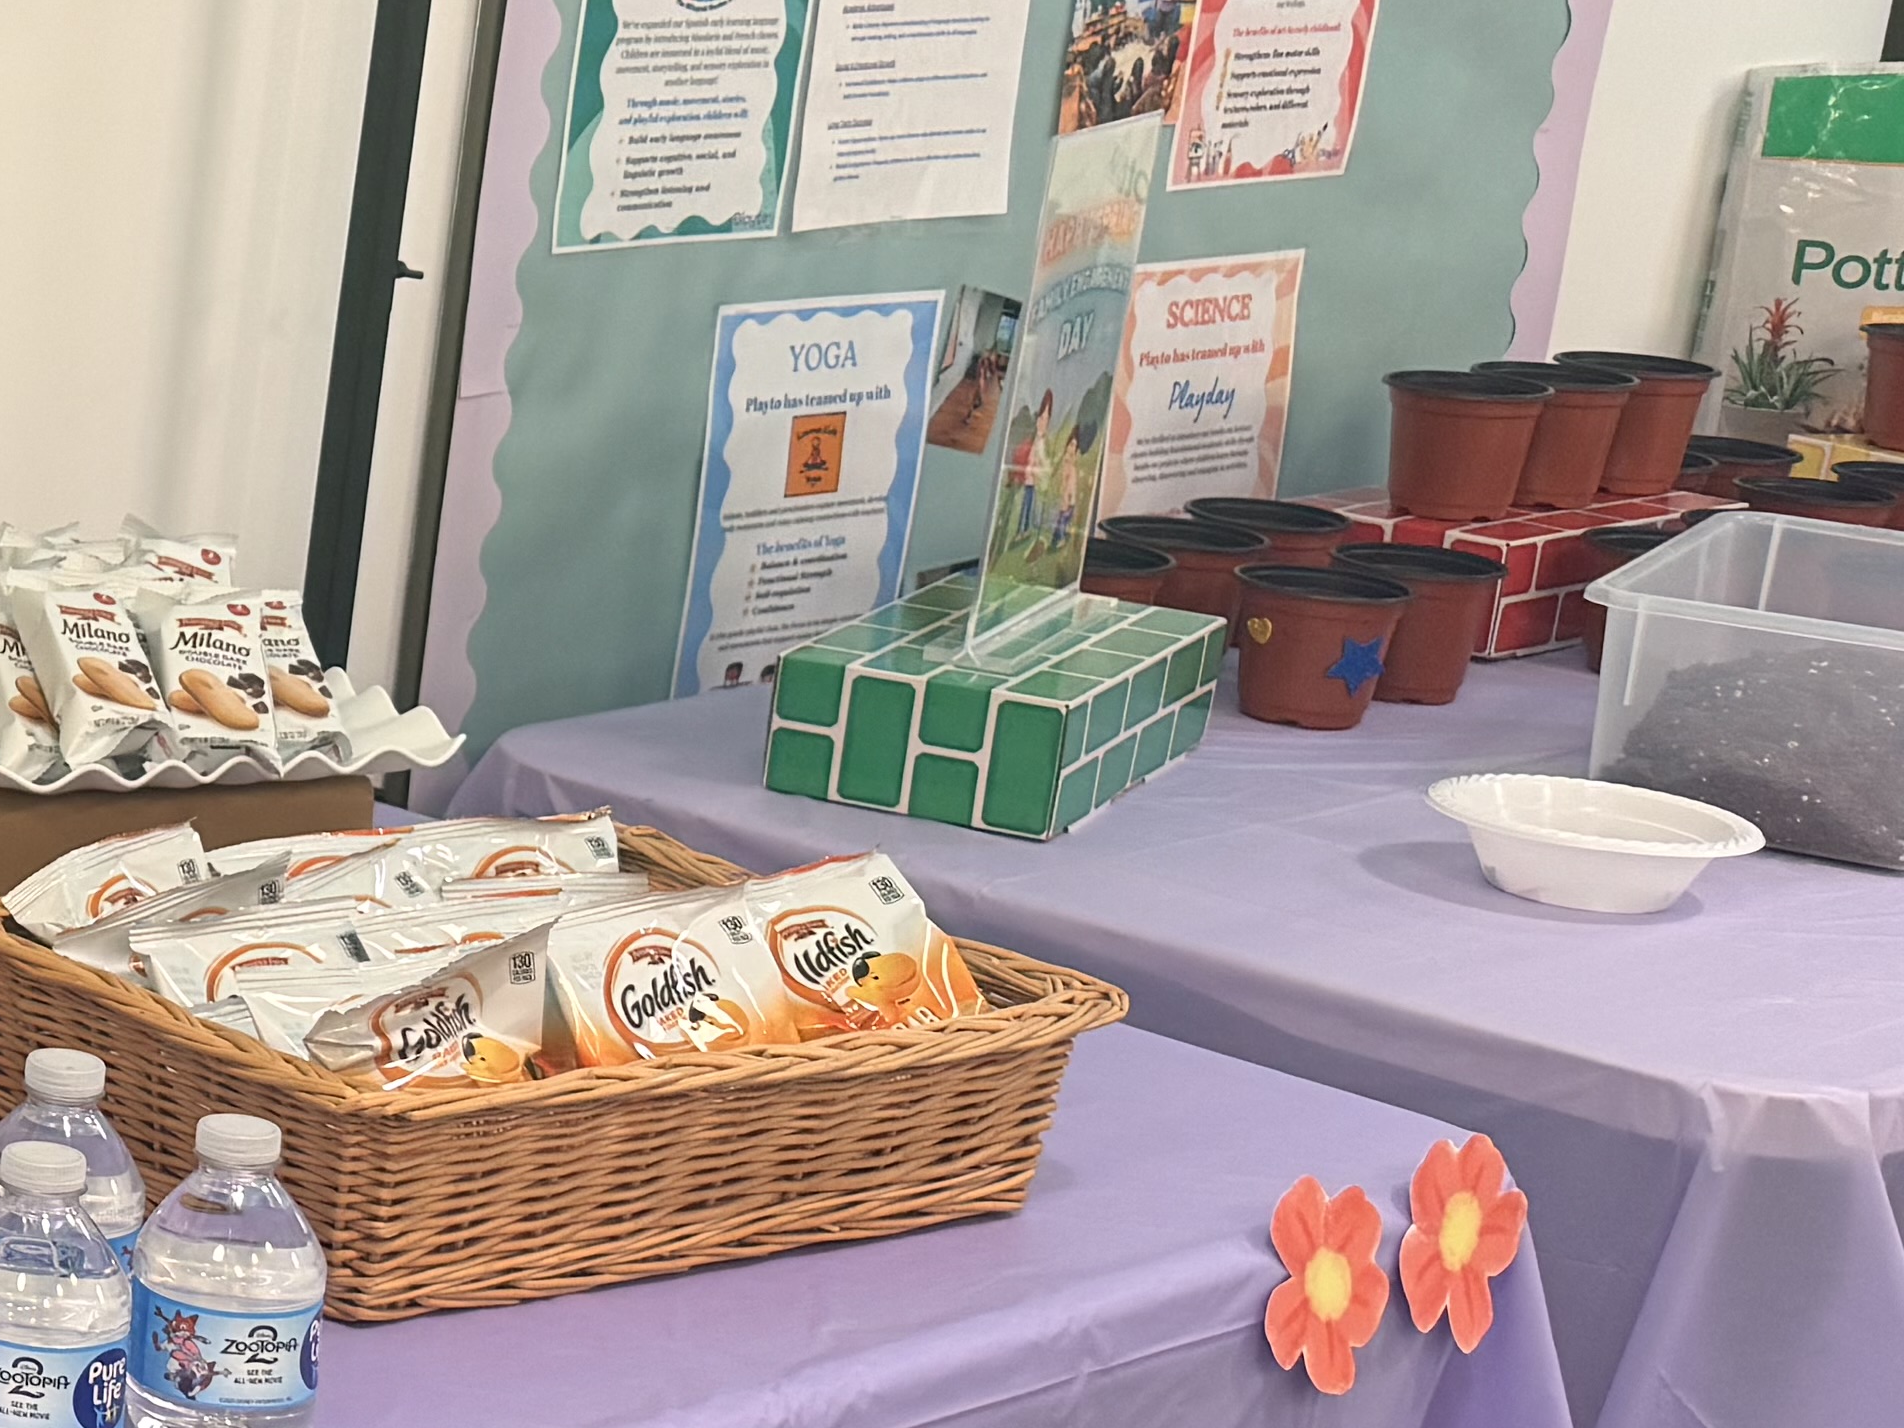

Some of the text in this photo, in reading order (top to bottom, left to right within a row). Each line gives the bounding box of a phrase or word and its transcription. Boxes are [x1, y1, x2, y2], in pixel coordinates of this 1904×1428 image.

[1166, 293, 1253, 330] SCIENCE
[1058, 309, 1095, 361] DAY
[790, 340, 858, 372] YOGA
[1172, 348, 1191, 364] has
[1192, 343, 1229, 361] teamed
[1229, 347, 1242, 360] up
[745, 384, 891, 415] Playto has teamed up with
[1168, 376, 1236, 423] Playday
[61, 618, 130, 644] Milano
[168, 631, 251, 657] Milano
[873, 876, 894, 893] 130
[721, 916, 743, 932] 130
[510, 953, 532, 969] 130
[220, 1338, 298, 1357] ZOOTOPIA
[88, 1357, 126, 1385] Pure
[93, 1380, 122, 1409] Life
